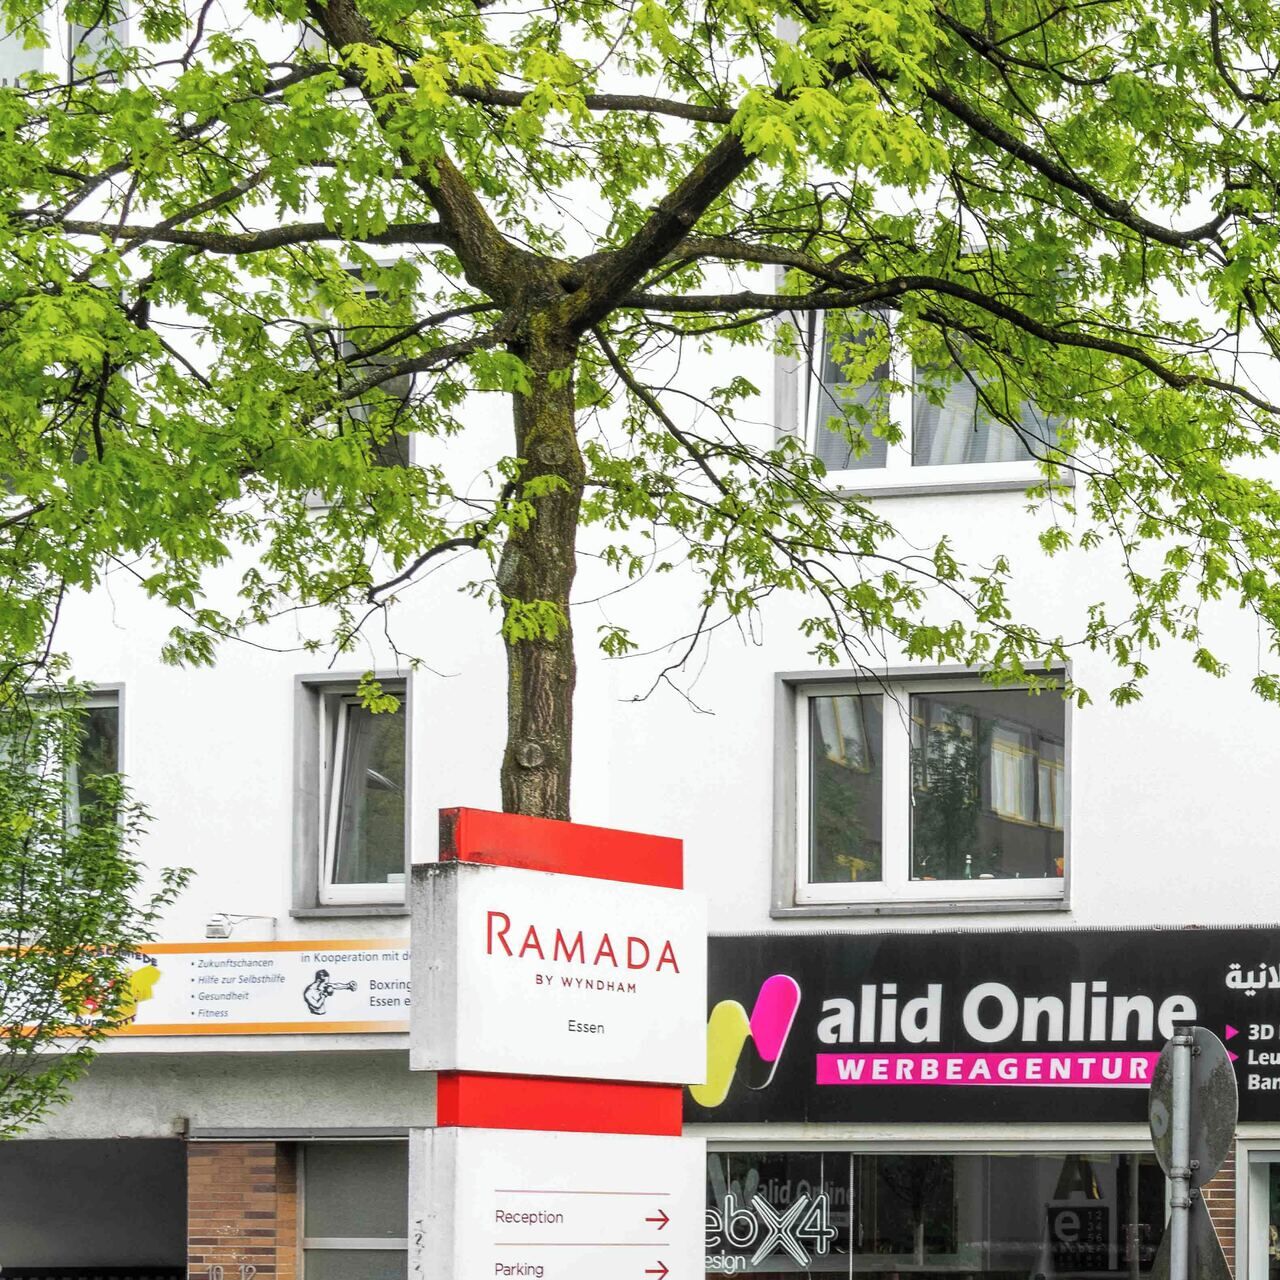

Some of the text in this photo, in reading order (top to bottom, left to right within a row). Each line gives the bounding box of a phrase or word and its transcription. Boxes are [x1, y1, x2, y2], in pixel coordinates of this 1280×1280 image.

[486, 910, 681, 974] RAMADA
[198, 958, 274, 968] Zukunftschancen
[301, 953, 310, 962] in
[314, 952, 378, 964] Kooperation
[382, 950, 399, 961] mit
[198, 973, 285, 984] Hilfe zur Selbsthilfe
[535, 974, 637, 994] BY WYNDHAM
[198, 991, 249, 1001] Gesundheit
[369, 996, 400, 1007] Essen
[198, 1008, 229, 1018] Fitness
[963, 981, 1198, 1044] Online
[567, 1019, 605, 1034] Essen
[1248, 1024, 1275, 1040] 3D
[836, 1056, 1149, 1082] WERBEAGENTUR
[495, 1210, 564, 1226] Reception
[494, 1263, 544, 1278] Parking
